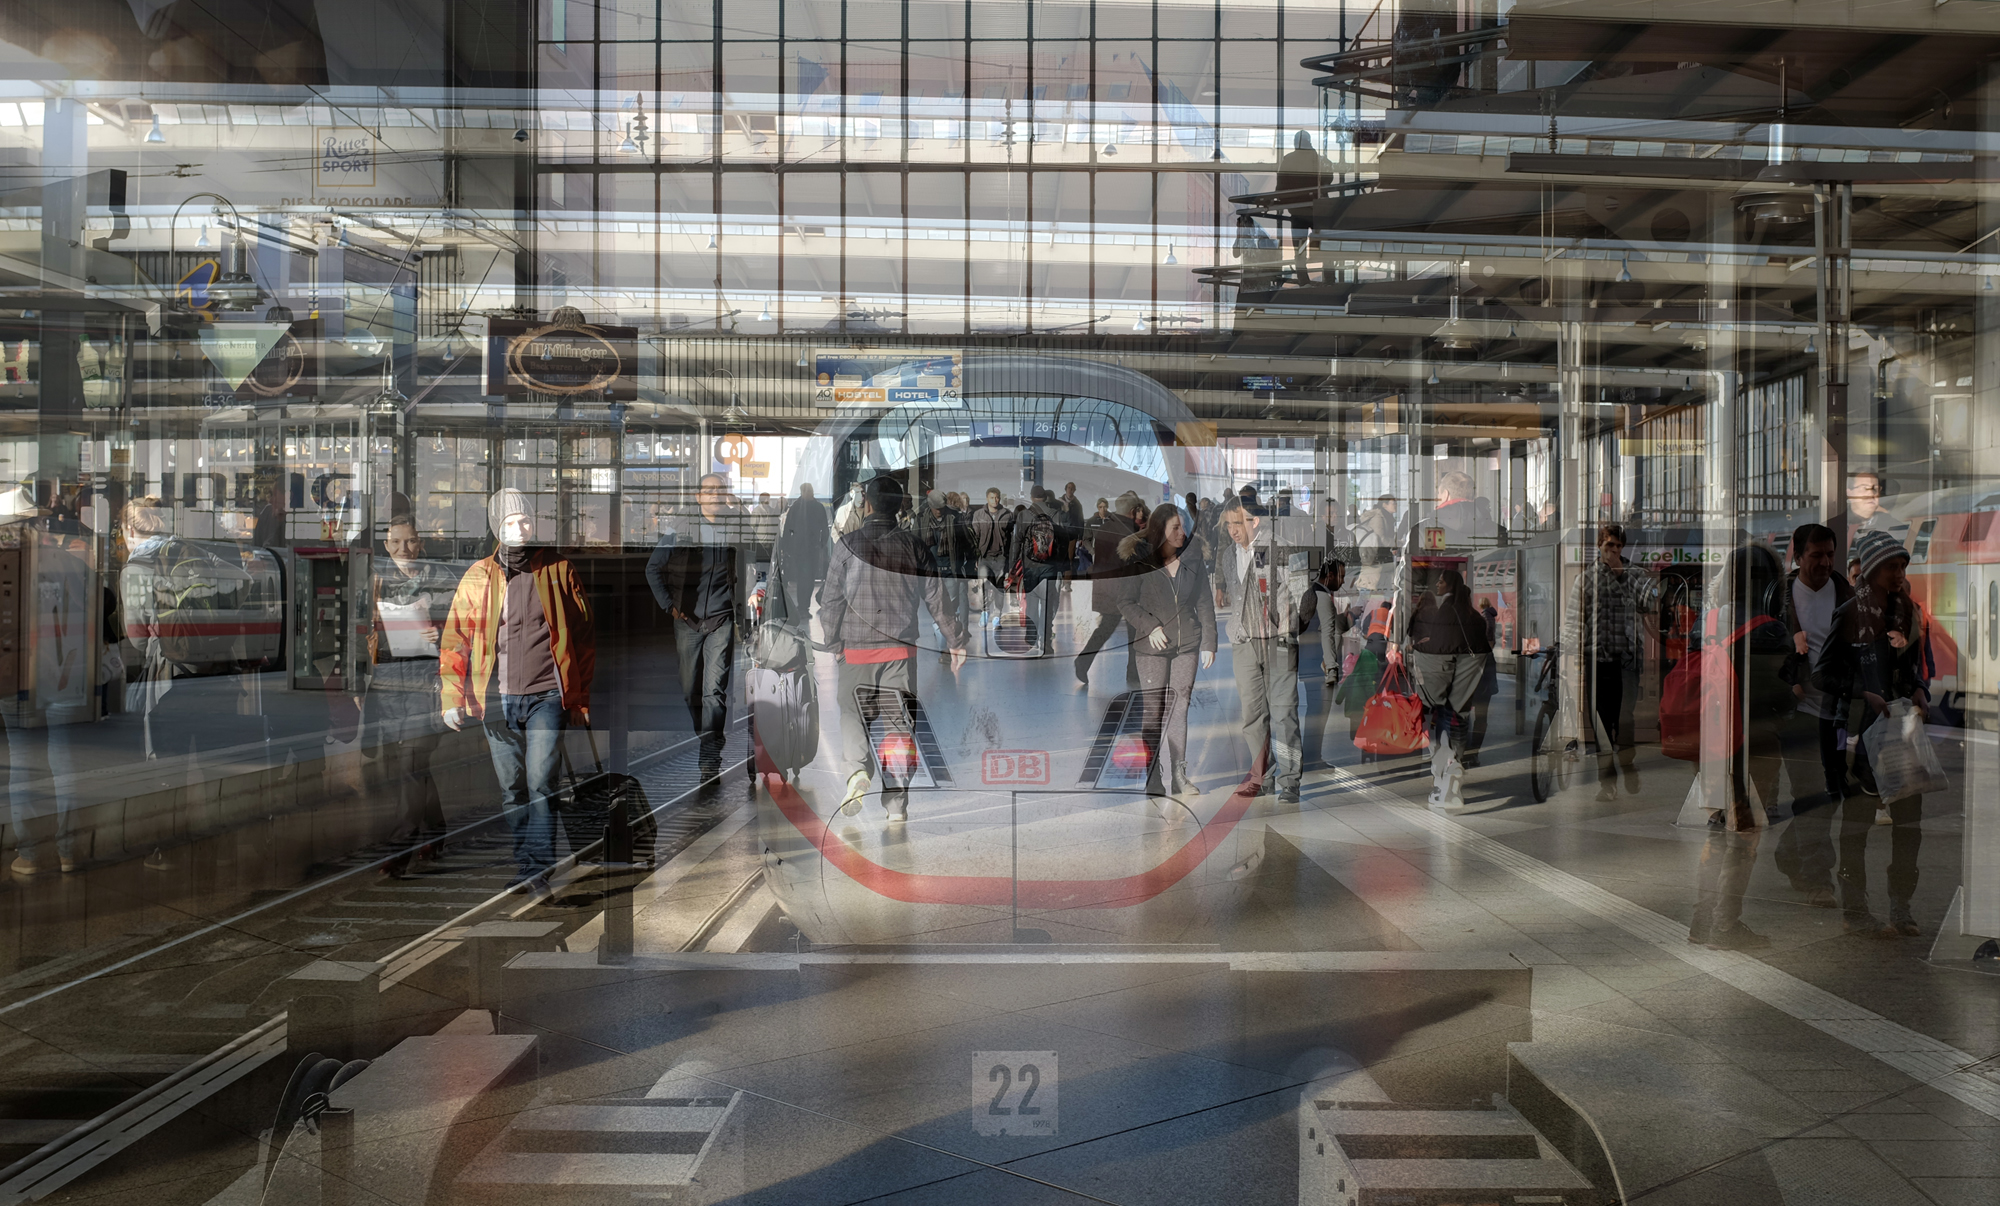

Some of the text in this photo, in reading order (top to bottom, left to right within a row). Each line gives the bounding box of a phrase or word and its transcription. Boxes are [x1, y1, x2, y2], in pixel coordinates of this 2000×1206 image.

[323, 136, 369, 159] Ritter
[323, 160, 369, 172] SPORT
[281, 197, 412, 206] DIE SCHOKOLADE
[837, 391, 882, 399] HOSTEL
[895, 391, 931, 399] HOTEL
[1035, 422, 1067, 433] 26-36
[1656, 441, 1706, 452] Souvenirs
[632, 472, 676, 482] NESPRESSO
[1428, 530, 1442, 548] T
[465, 545, 473, 553] 17
[1640, 547, 1722, 562] zoells.de
[990, 754, 1042, 778] DB
[989, 1064, 1040, 1115] 22
